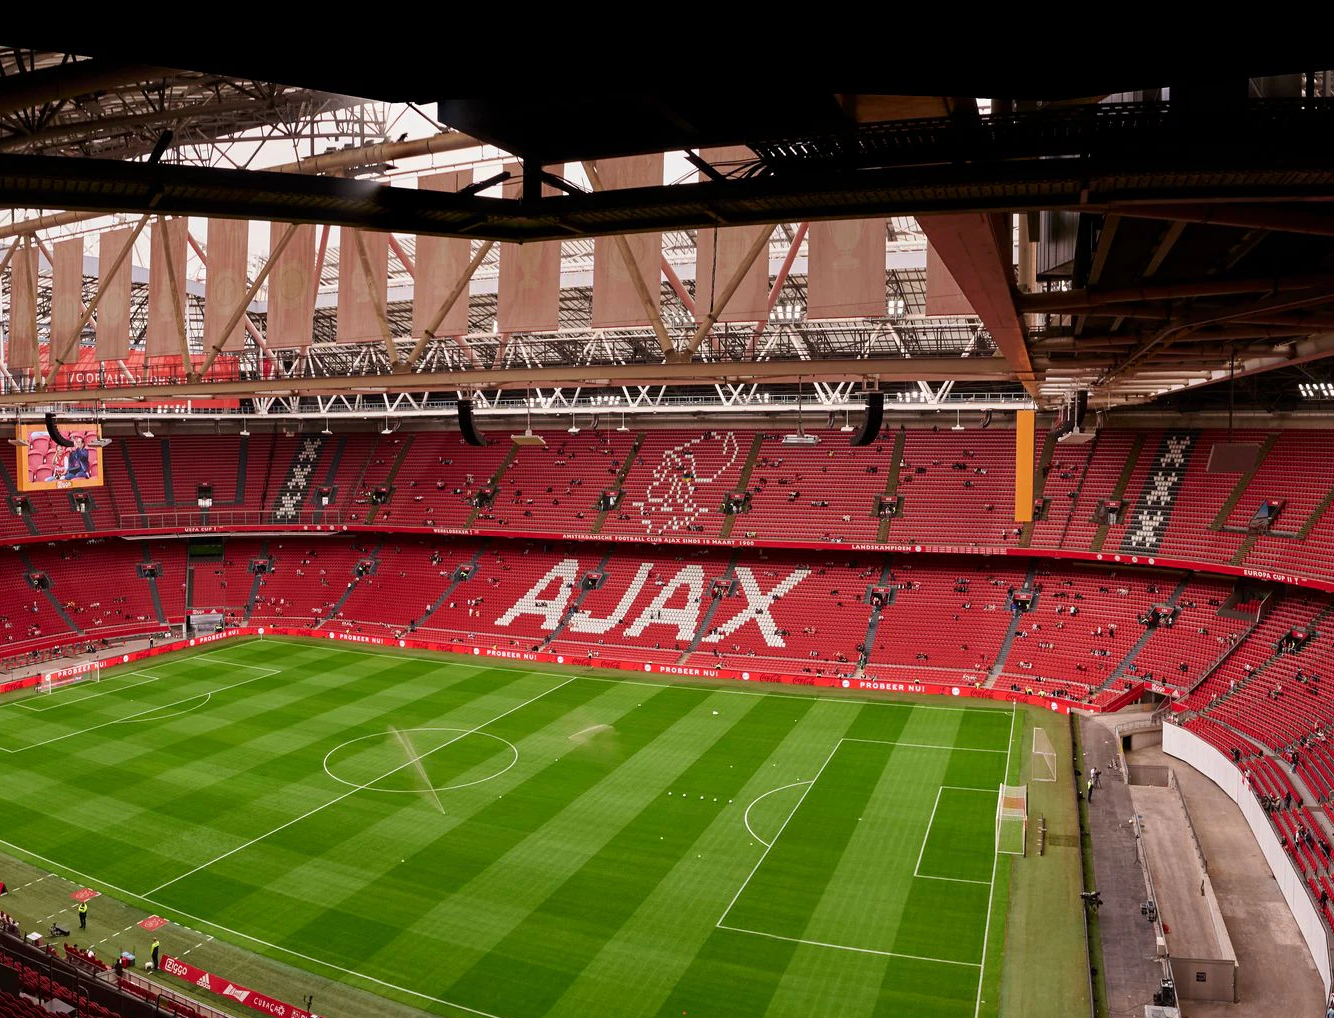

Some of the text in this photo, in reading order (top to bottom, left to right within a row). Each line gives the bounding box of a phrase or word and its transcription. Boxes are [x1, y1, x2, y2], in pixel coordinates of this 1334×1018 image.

[1243, 569, 1271, 579] EUROPA
[1272, 573, 1286, 582] CUP
[494, 558, 811, 648] AJAX
[339, 634, 369, 643] PROBEER
[487, 649, 521, 659] PROBEER
[659, 666, 699, 676] PROBEER
[859, 682, 905, 691] PROBEER
